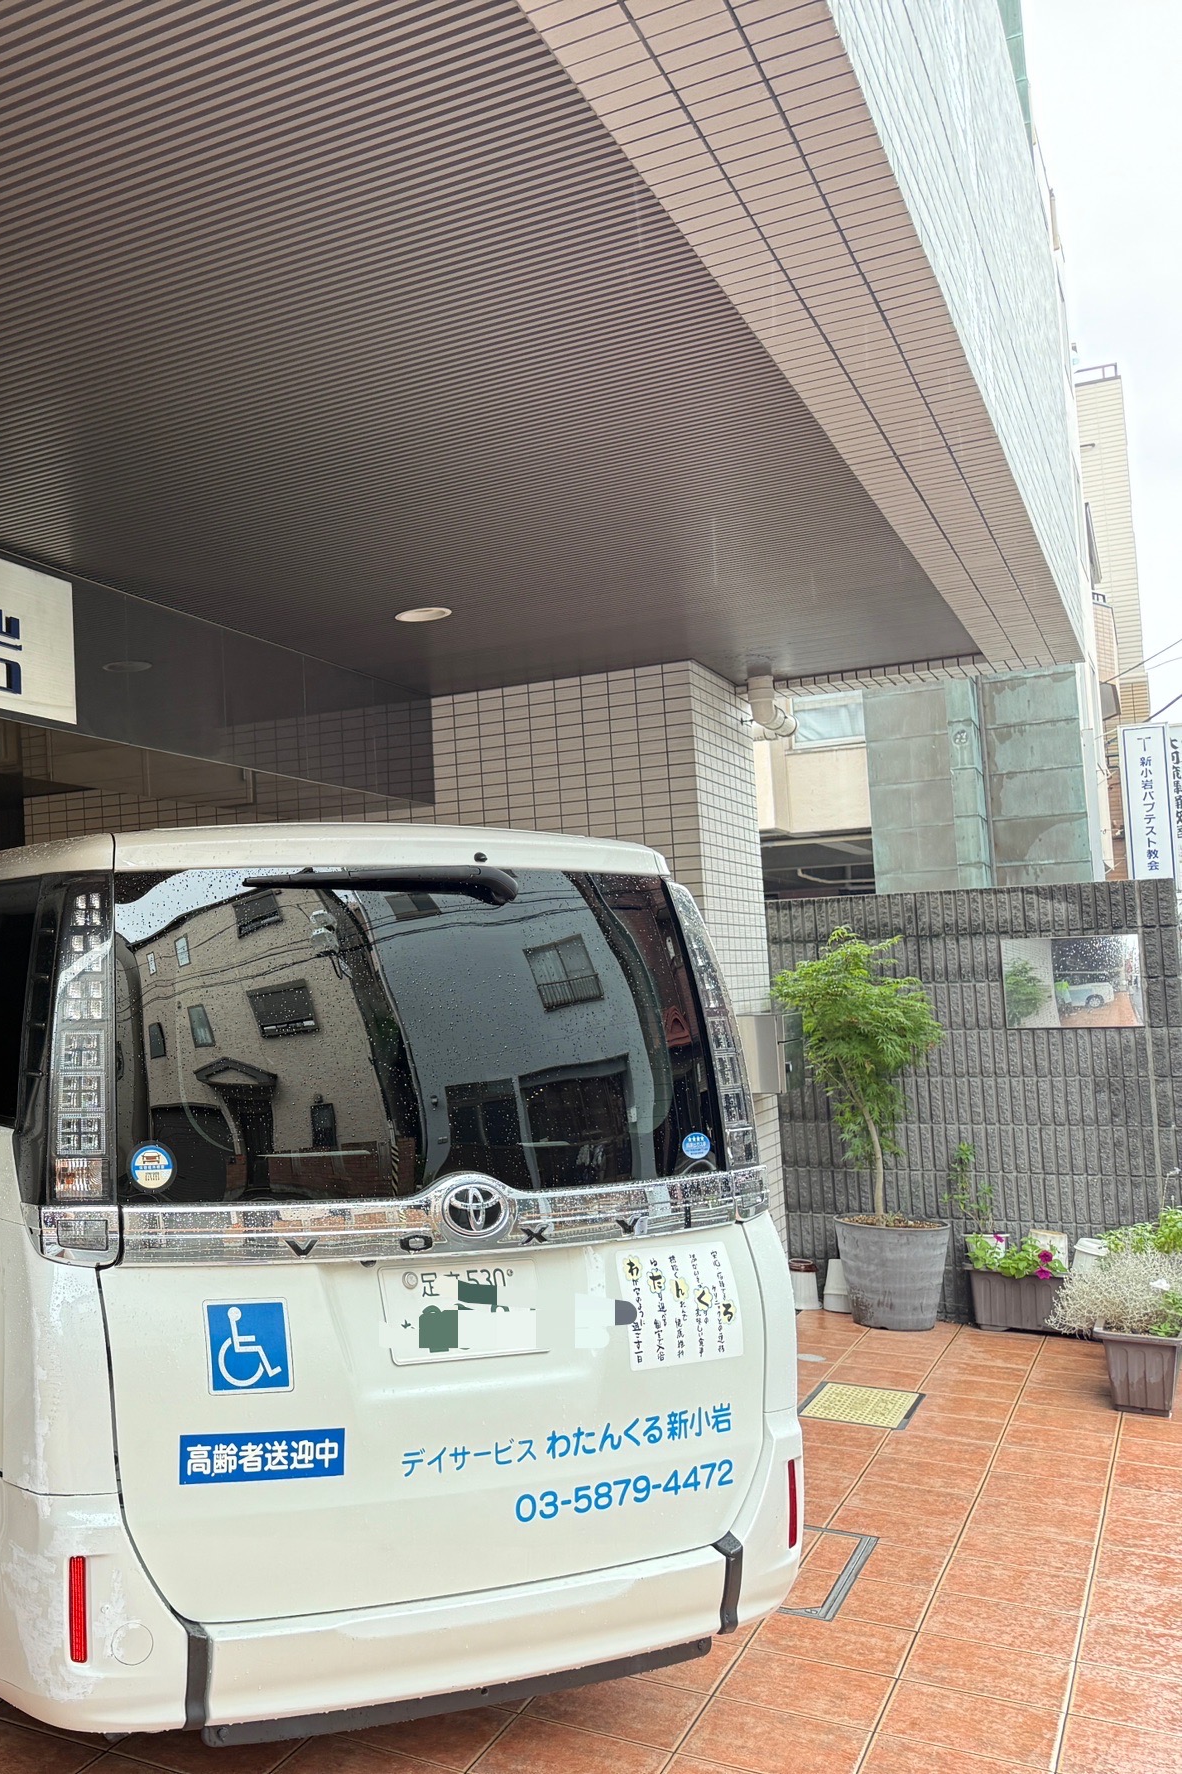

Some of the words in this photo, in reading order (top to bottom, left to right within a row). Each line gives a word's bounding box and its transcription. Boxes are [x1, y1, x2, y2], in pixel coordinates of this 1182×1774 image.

[1139, 755, 1159, 871] 新小岩バプテスト教会
[285, 1216, 642, 1258] VOXY
[185, 1439, 340, 1479] 高齢者送迎中
[402, 1439, 539, 1478] デイサービス
[516, 1460, 735, 1524] 03-5879-4472
